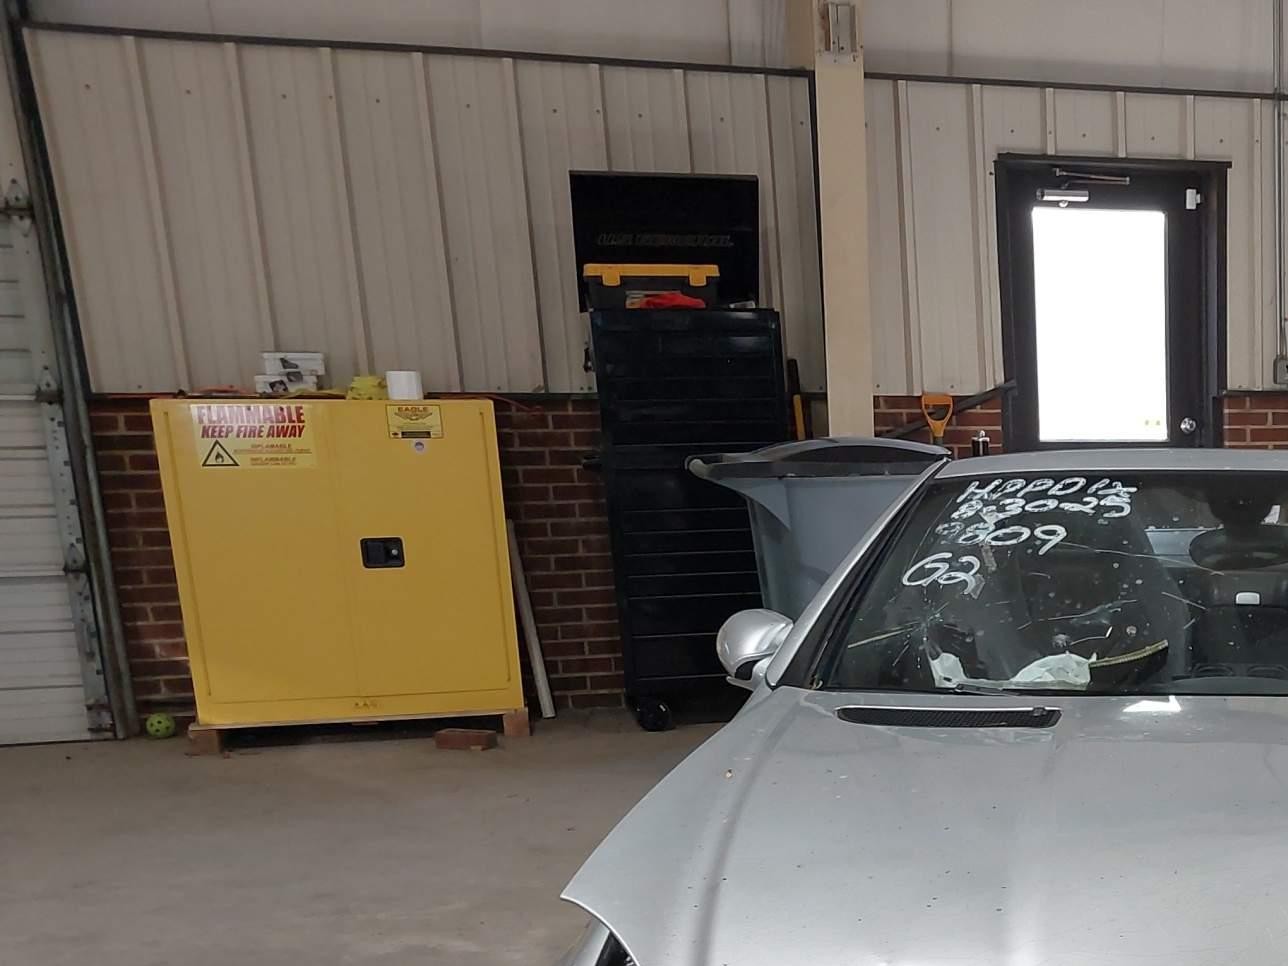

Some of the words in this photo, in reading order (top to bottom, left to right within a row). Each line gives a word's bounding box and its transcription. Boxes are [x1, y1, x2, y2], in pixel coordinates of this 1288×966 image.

[197, 405, 306, 425] FLAMMABLE
[201, 425, 234, 439] KEEP
[236, 425, 265, 439] FIRE
[266, 425, 305, 438] AWAY
